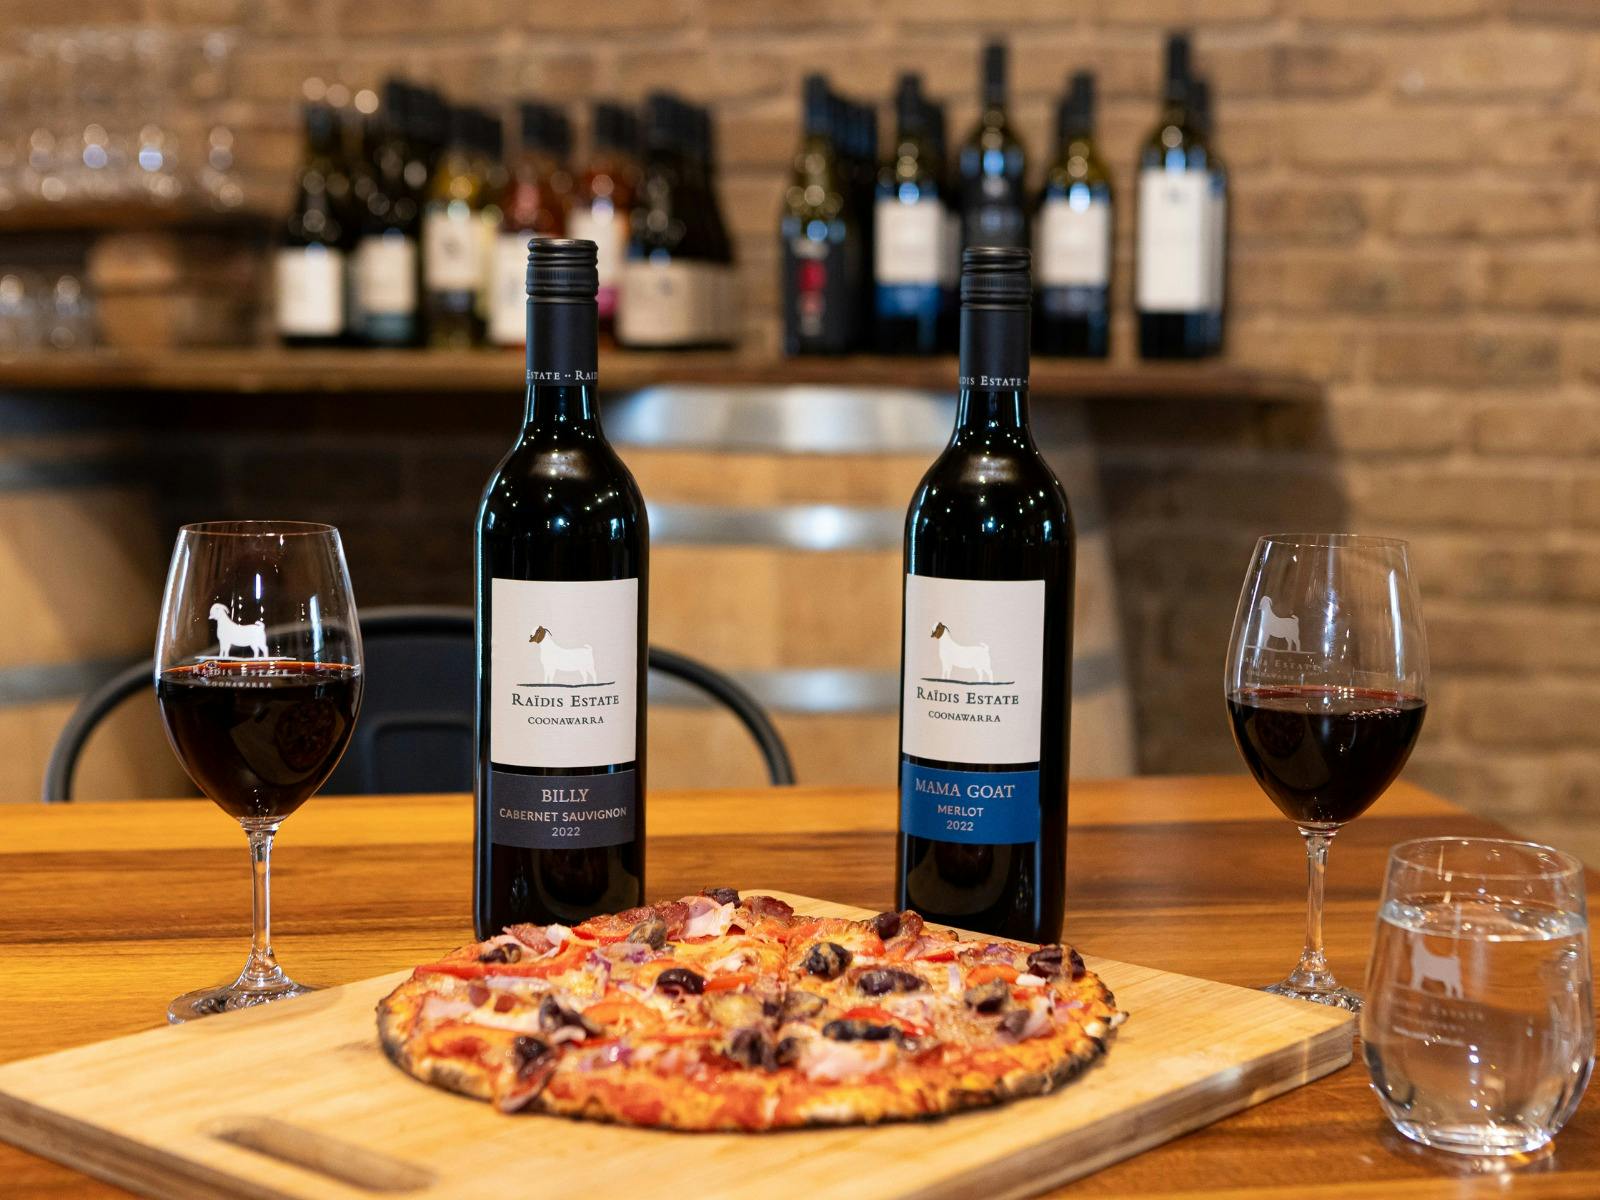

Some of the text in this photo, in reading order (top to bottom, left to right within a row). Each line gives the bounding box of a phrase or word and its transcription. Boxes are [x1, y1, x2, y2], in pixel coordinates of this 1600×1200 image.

[526, 369, 560, 380] ESTATE
[980, 375, 1022, 387] ESTATE
[512, 693, 620, 708] RAÏDIS ESTATE
[916, 686, 1019, 705] RAÏDIS ESTATE
[527, 716, 605, 725] COONAWARRA
[928, 711, 1001, 723] COONAWARRA
[915, 777, 1016, 798] MAMA GOAT
[541, 788, 590, 803] BILLY
[499, 806, 627, 822] CABERNET SAUVIGNON
[937, 804, 984, 817] MERLOT
[551, 826, 581, 837] 2022
[946, 820, 974, 832] 2022
